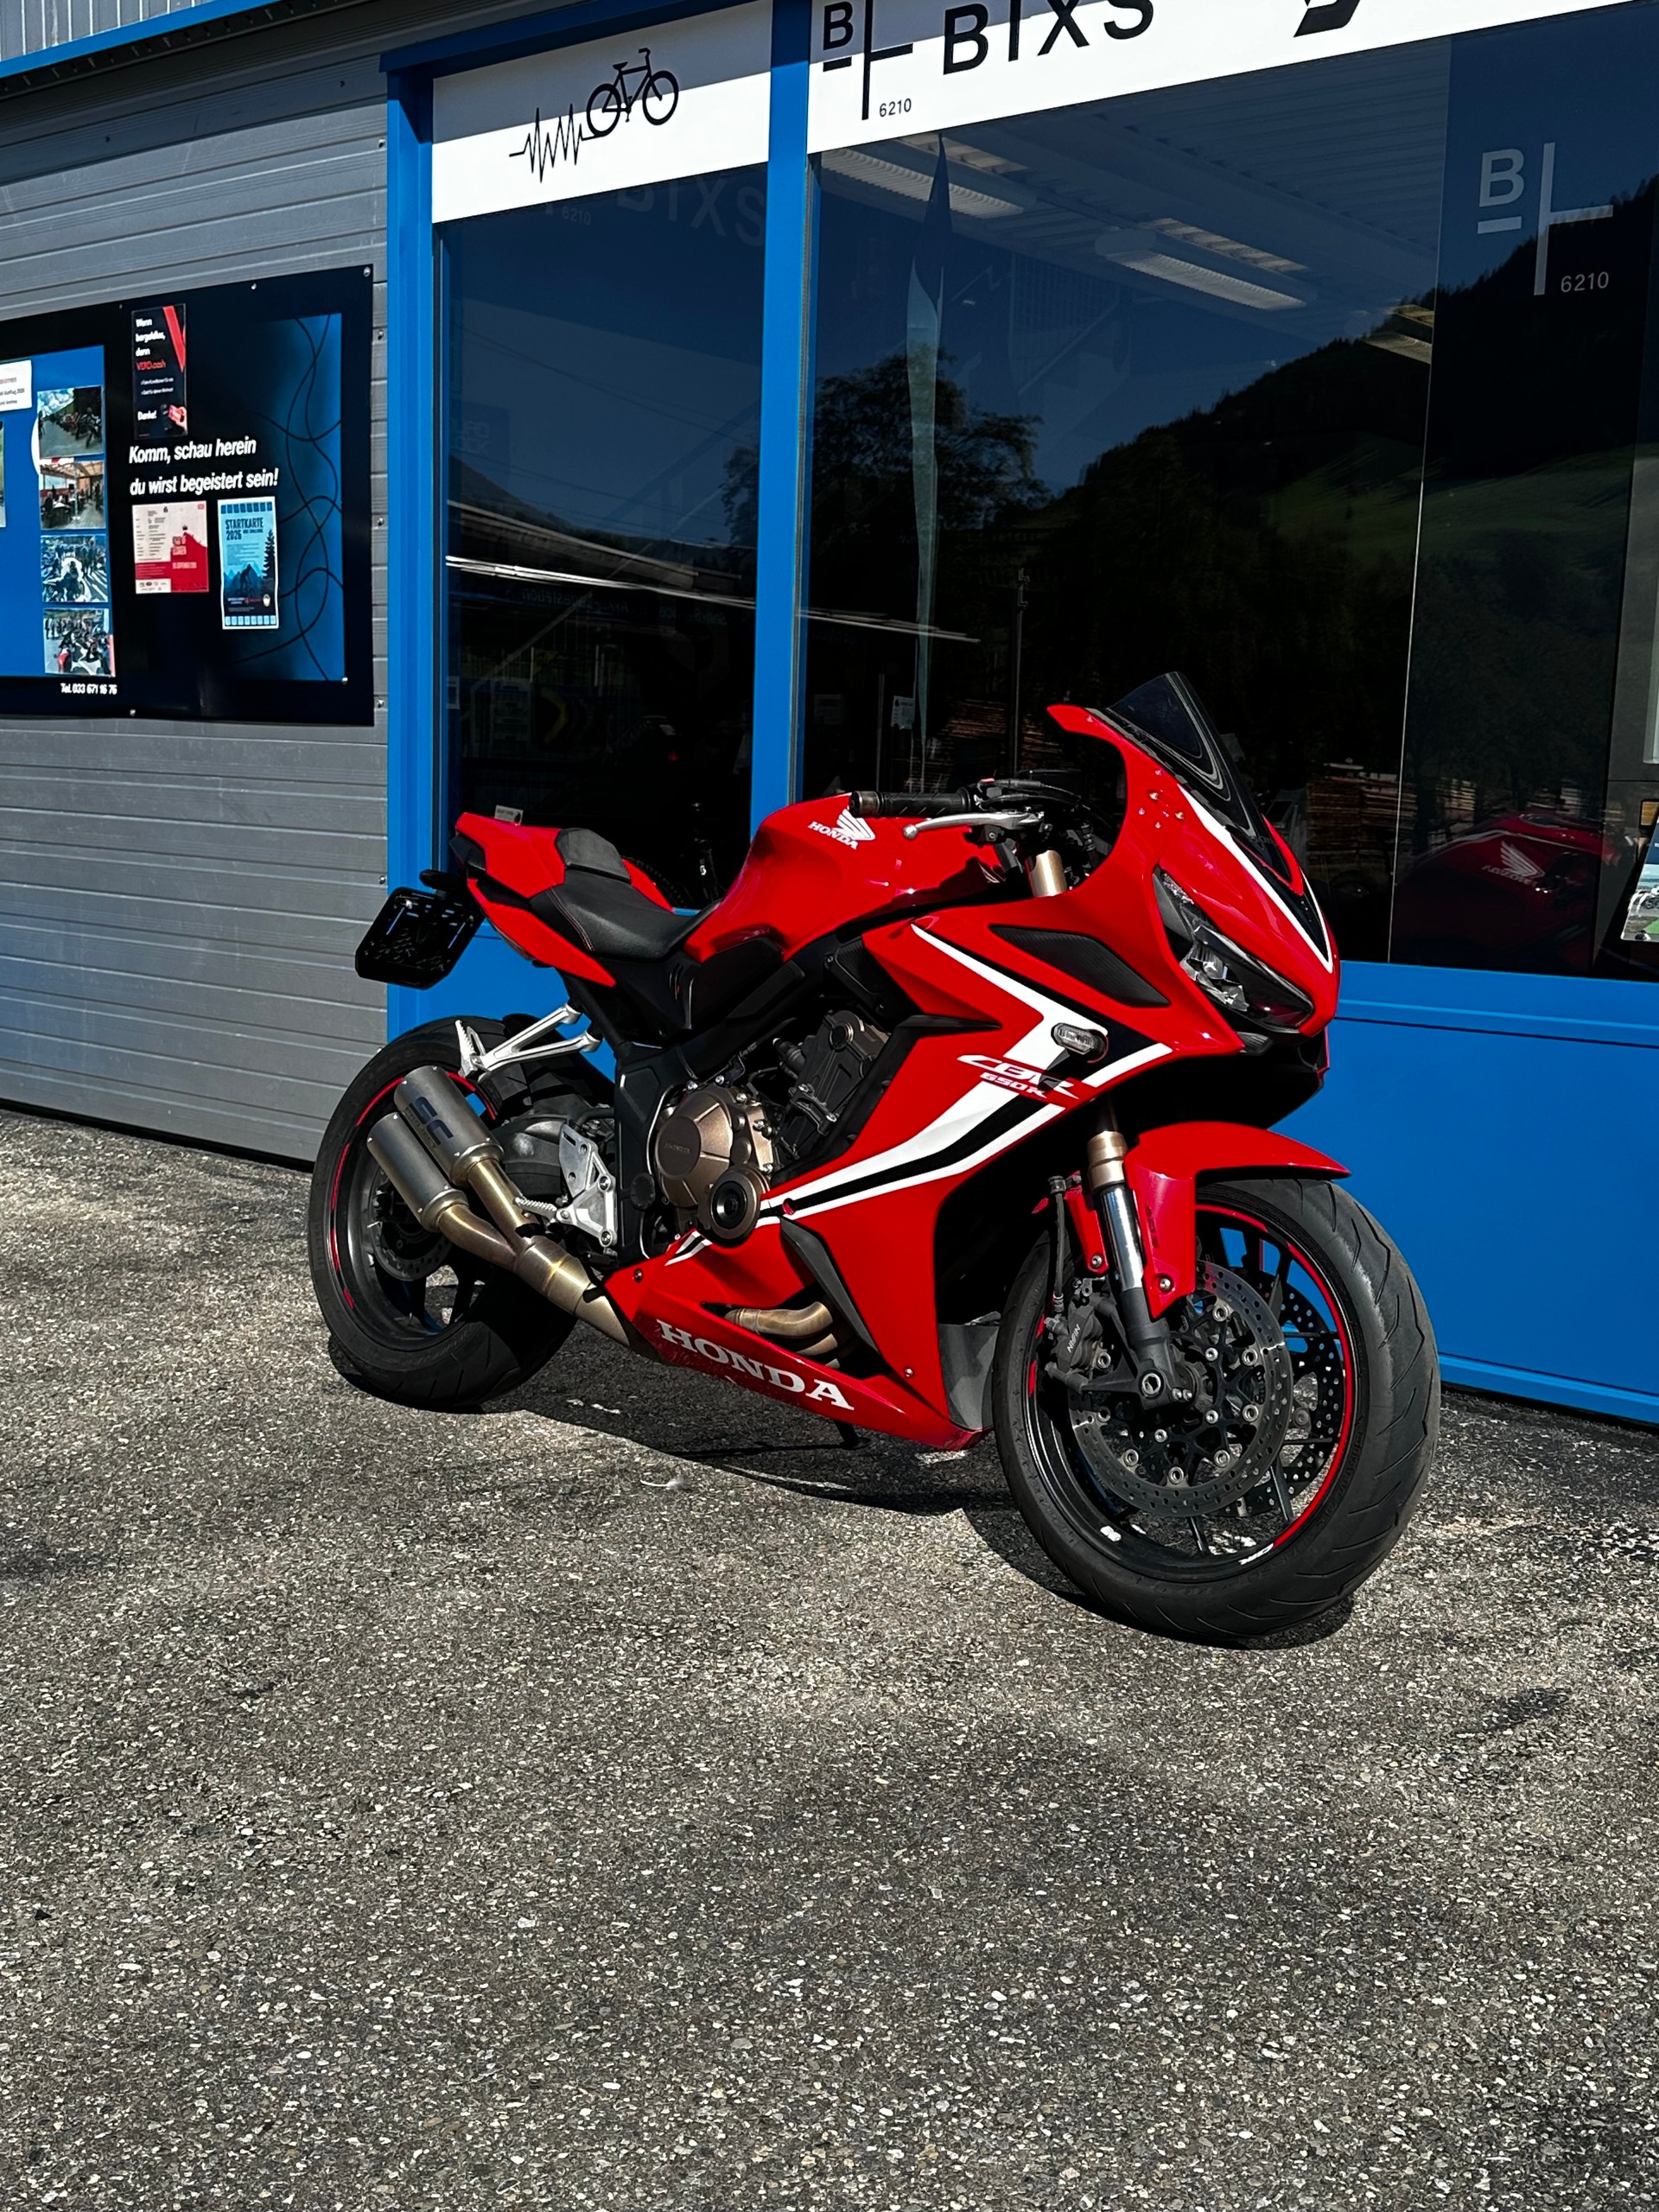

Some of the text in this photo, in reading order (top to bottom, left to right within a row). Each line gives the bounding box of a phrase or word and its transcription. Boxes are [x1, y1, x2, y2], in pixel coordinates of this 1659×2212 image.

[943, 0, 1154, 75] BIXS
[879, 98, 912, 118] 6210
[1478, 148, 1525, 208] B
[561, 205, 593, 226] 6210
[1560, 271, 1610, 293] 6210
[129, 435, 257, 464] Komm, schau herein
[130, 467, 279, 496] du wirst begeistert sein!
[808, 821, 859, 849] HONDA
[957, 1054, 1080, 1100] CBR
[979, 1071, 1047, 1099] 650R
[656, 1319, 855, 1411] HONDA
